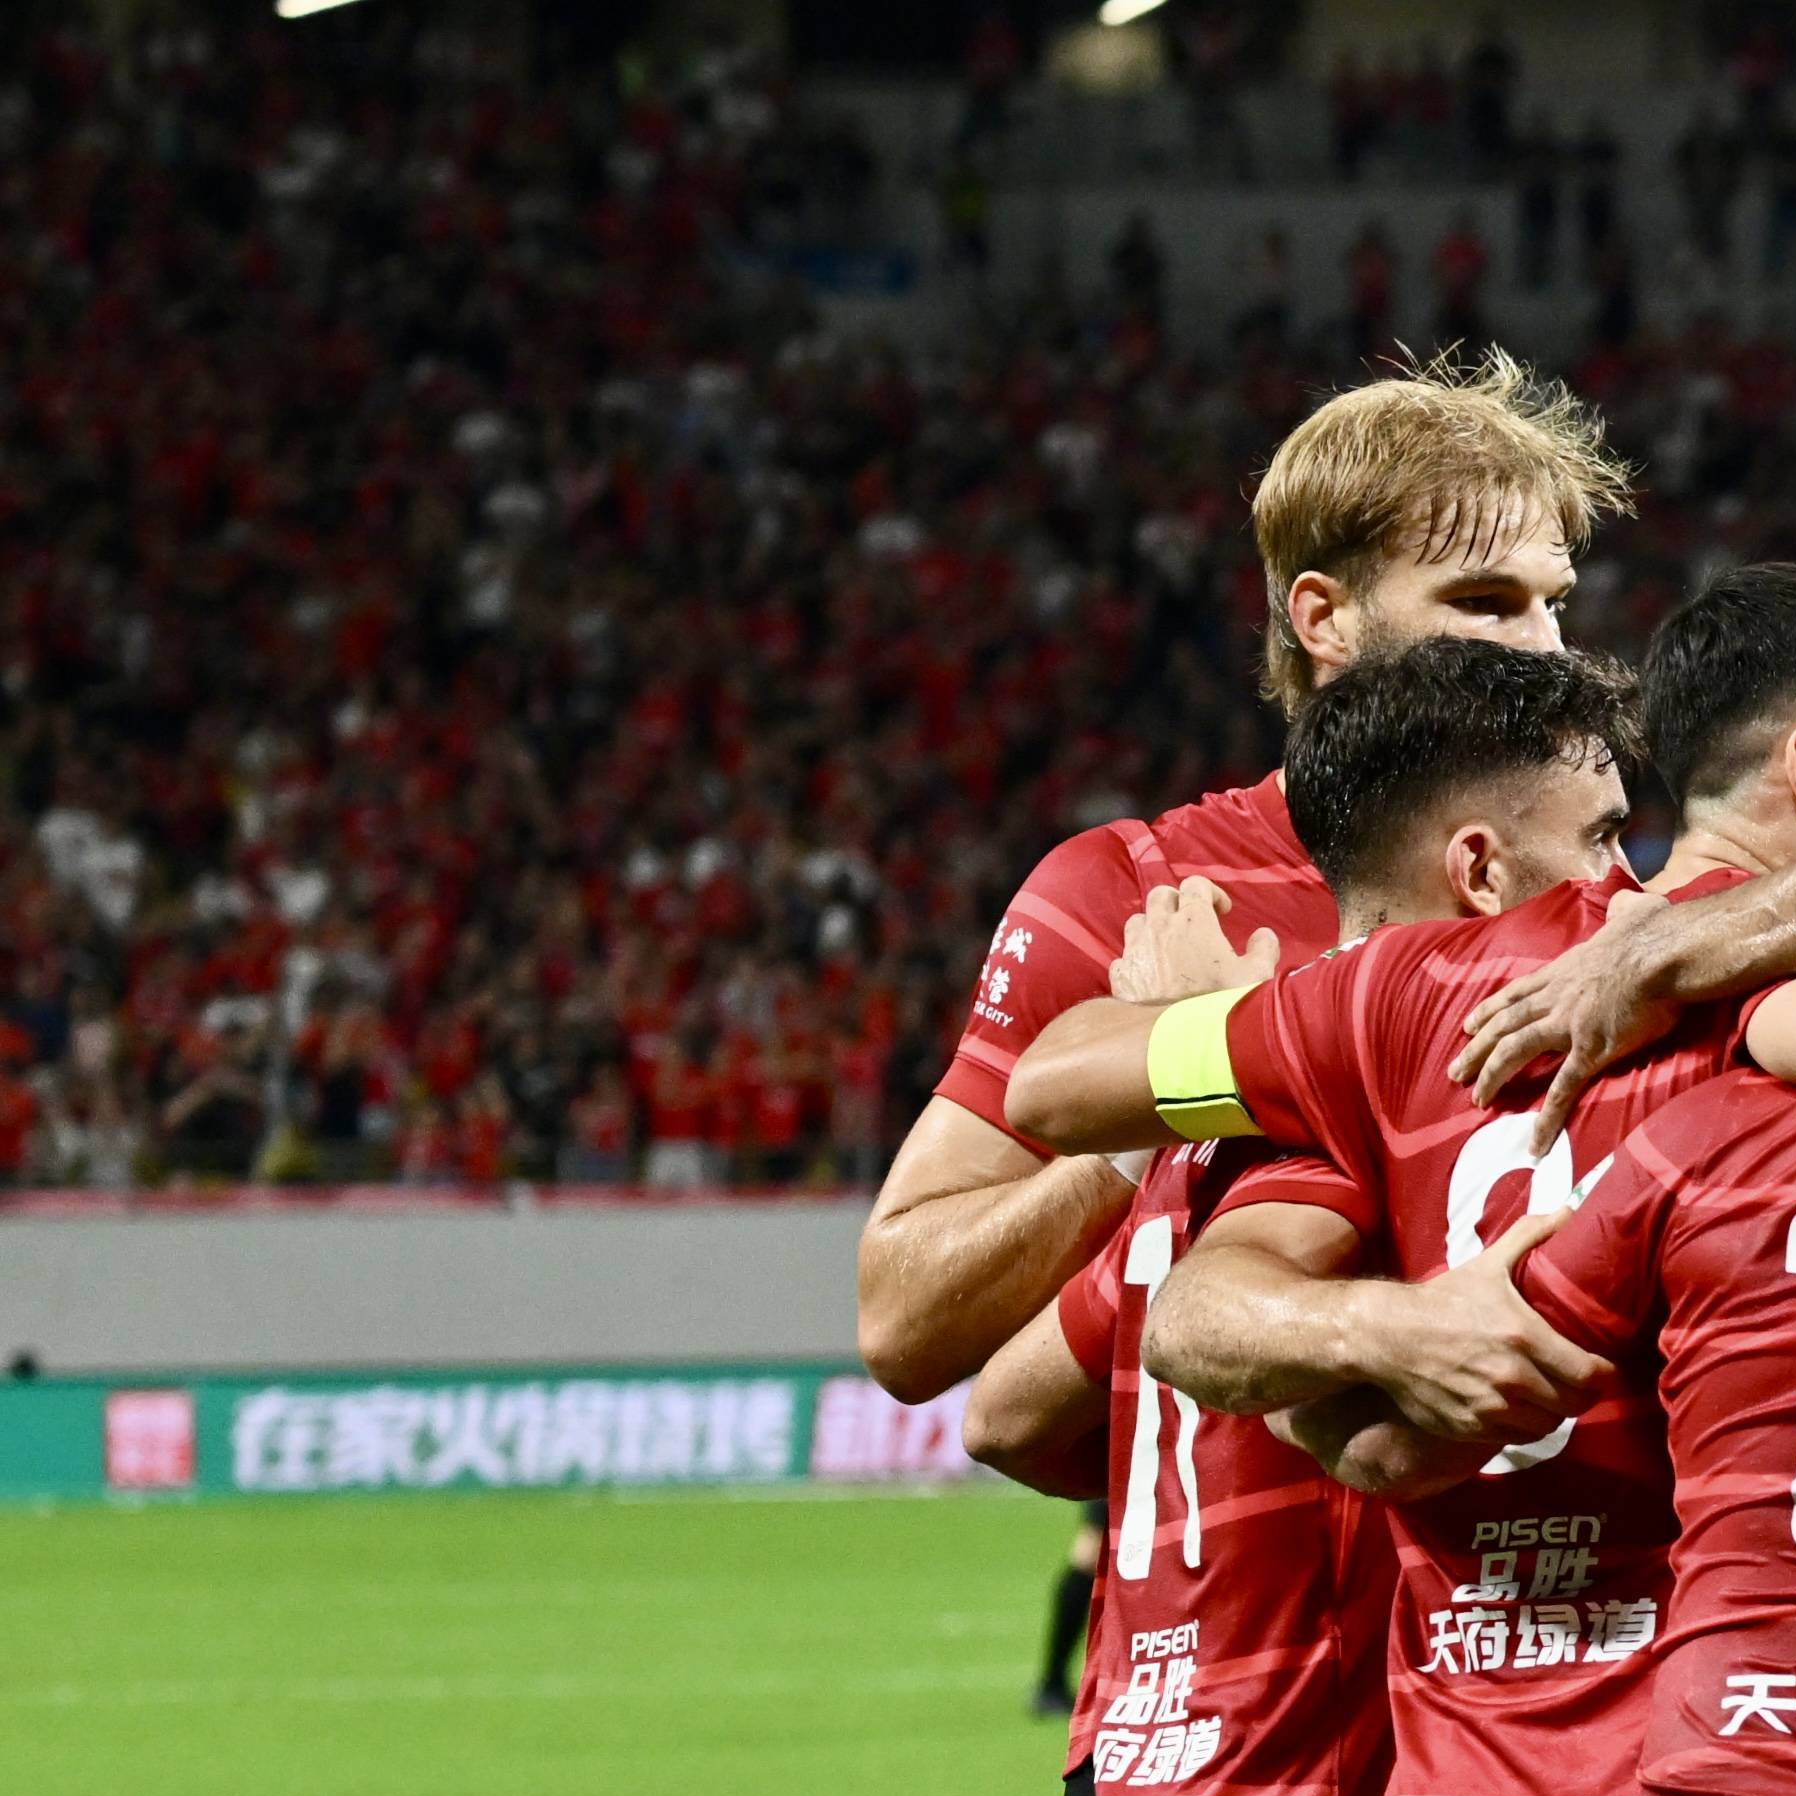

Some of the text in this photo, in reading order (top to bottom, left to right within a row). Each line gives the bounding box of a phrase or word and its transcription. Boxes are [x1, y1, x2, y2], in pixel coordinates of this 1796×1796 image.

[1471, 1514, 1602, 1550] PISEN
[1450, 1547, 1600, 1603] 品胜
[1130, 1621, 1200, 1662] PISEN
[1416, 1597, 1658, 1675] 天府绿道
[1101, 1655, 1198, 1726] 品胜
